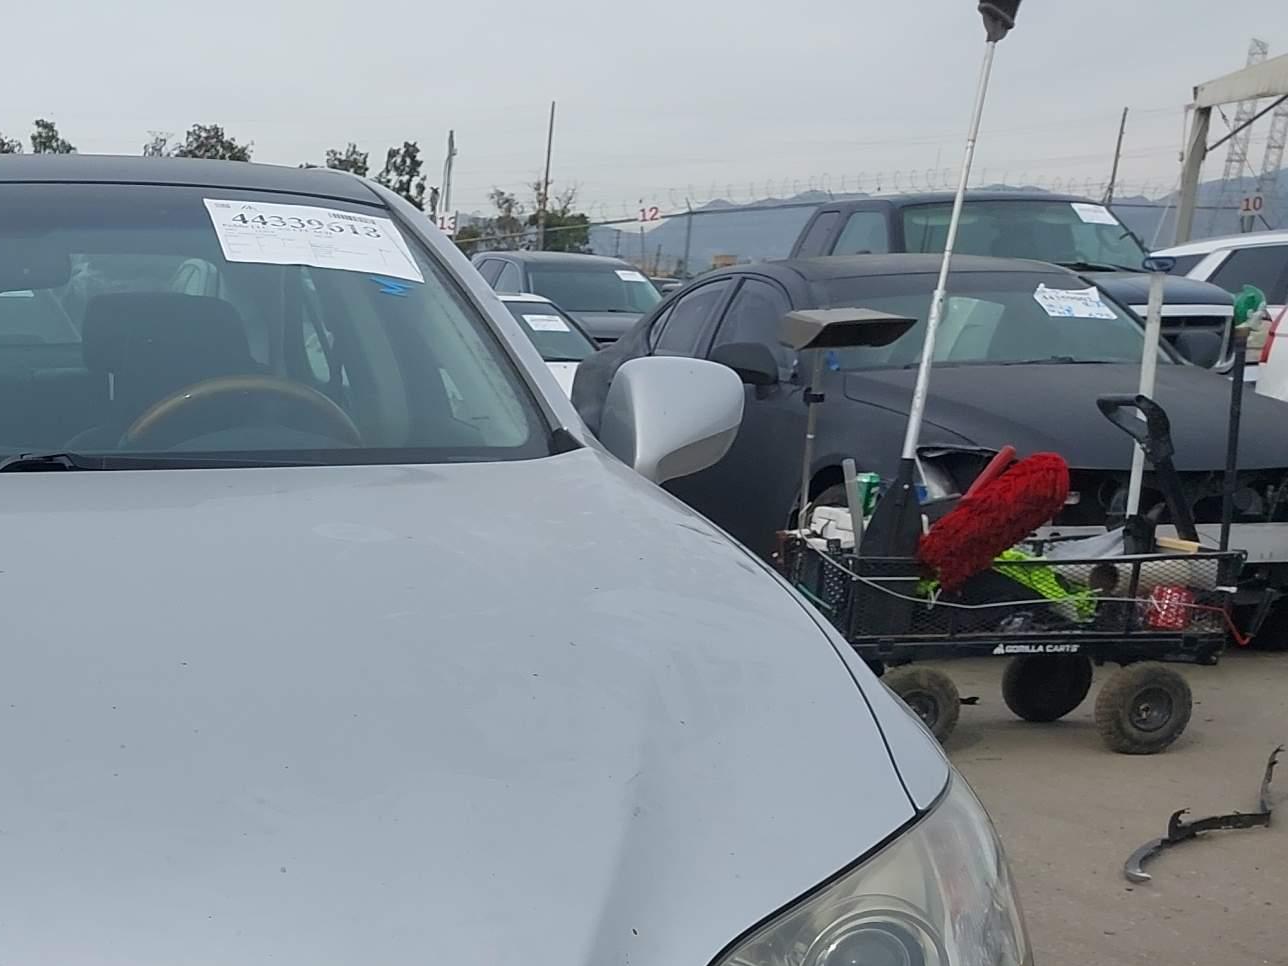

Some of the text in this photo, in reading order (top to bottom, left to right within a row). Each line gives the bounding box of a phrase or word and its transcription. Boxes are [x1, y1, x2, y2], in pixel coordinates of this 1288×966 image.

[1242, 196, 1263, 212] 10
[639, 207, 660, 222] 12
[438, 215, 456, 231] 13
[1005, 644, 1079, 653] GORILLA CARTS
